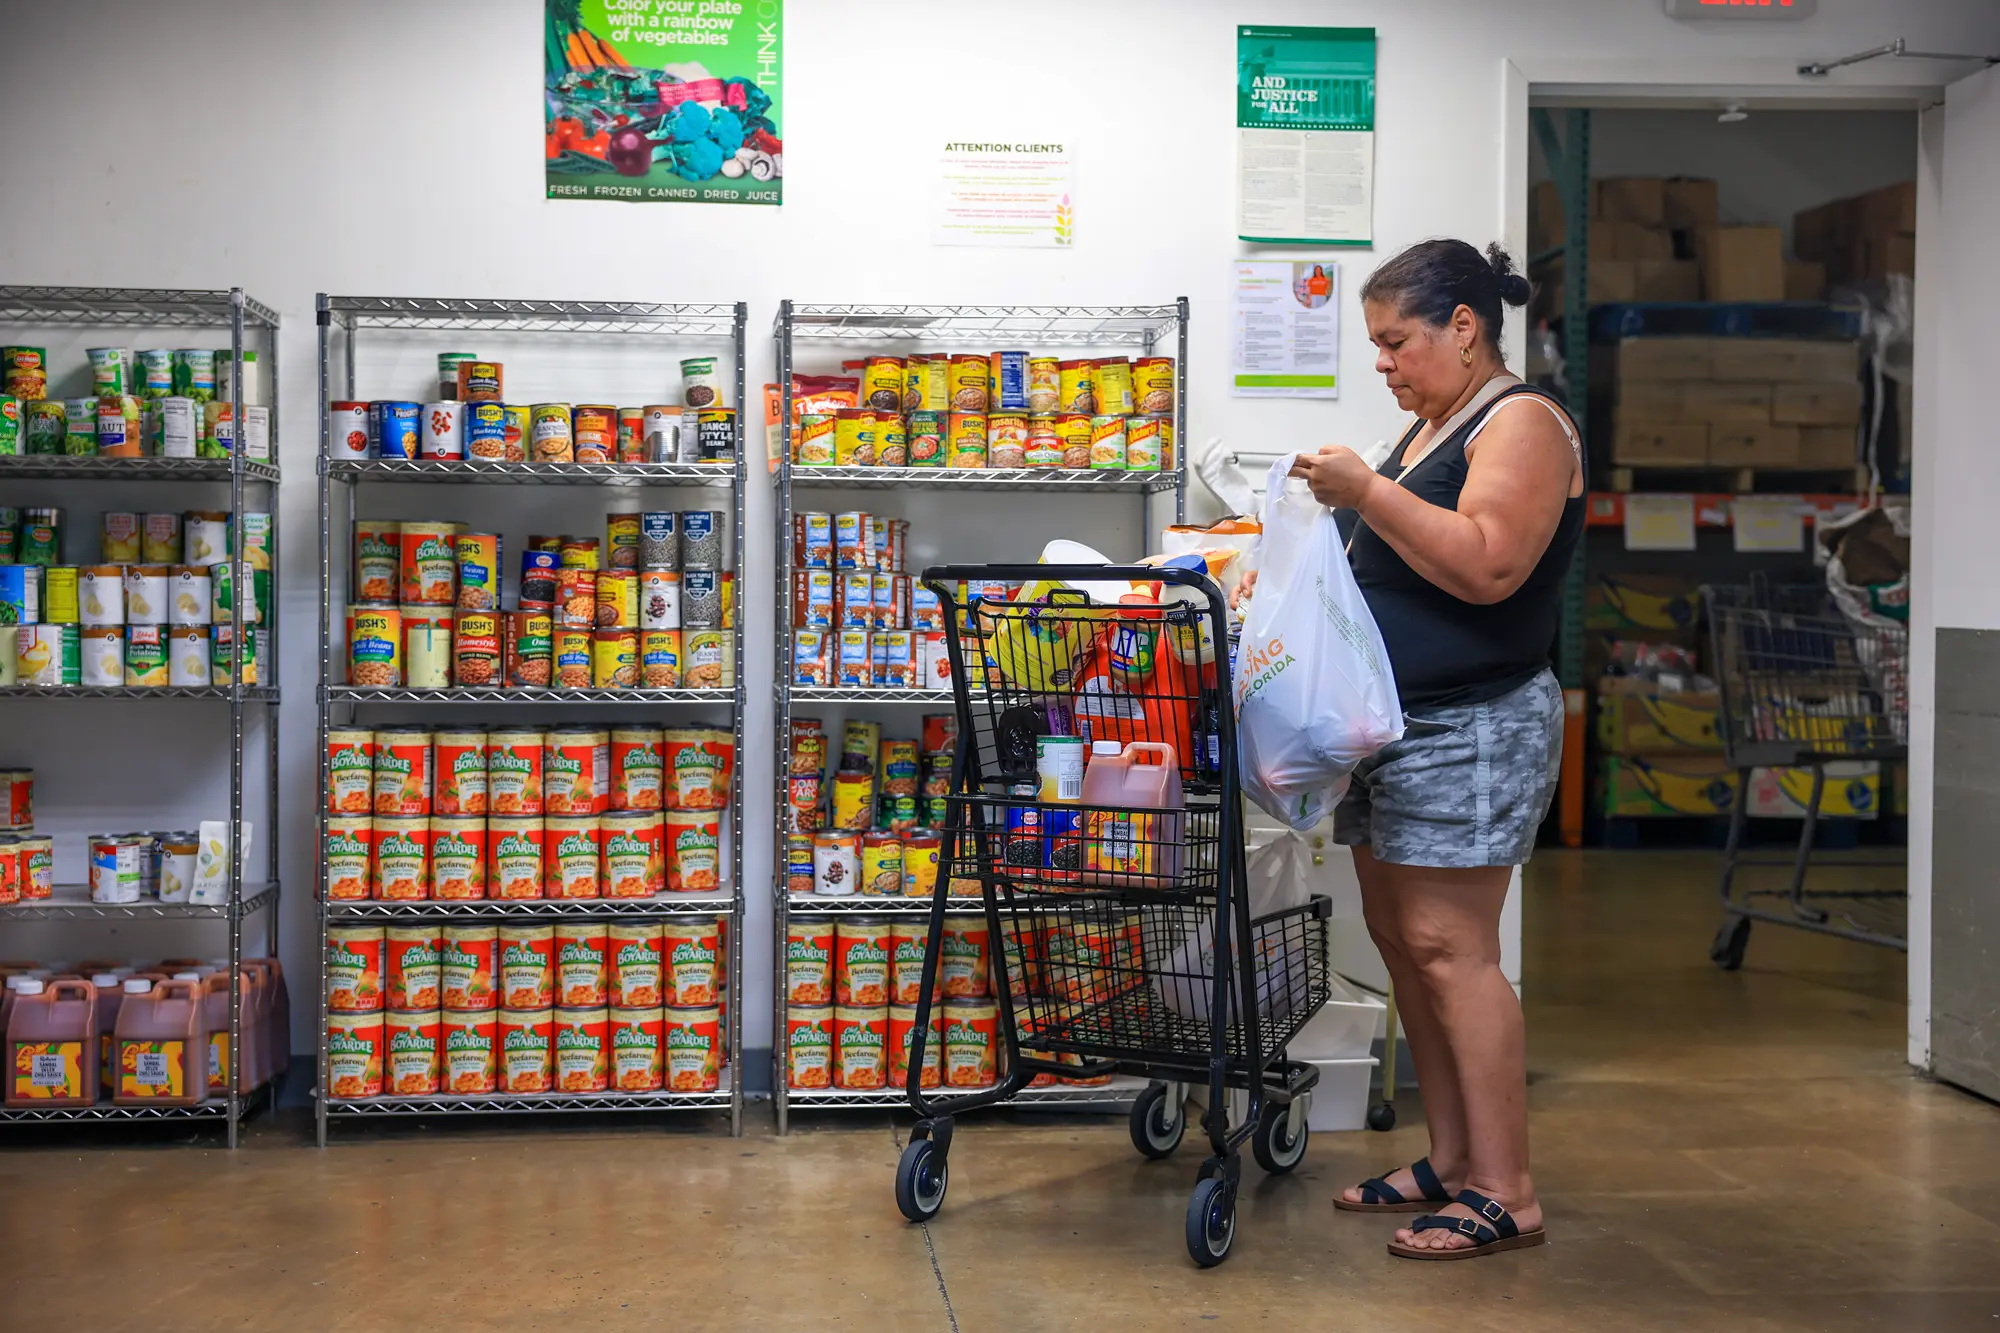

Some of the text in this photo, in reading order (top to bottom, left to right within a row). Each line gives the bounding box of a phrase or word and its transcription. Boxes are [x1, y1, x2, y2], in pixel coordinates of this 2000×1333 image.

[604, 0, 651, 11] Color
[656, 0, 695, 17] your
[699, 0, 742, 19] plate
[608, 13, 733, 30] with a rainbow
[611, 28, 729, 46] of vegetables
[757, 22, 776, 88] THINK
[1252, 76, 1286, 88] AND
[1251, 89, 1318, 102] JUSTICE
[1269, 102, 1298, 114] ALL
[945, 143, 1063, 153] ATTENTION CLIENTS
[550, 185, 778, 200] FRESH FROZEN CANNED DRIED JUICE
[701, 423, 730, 431] RANCH
[991, 418, 1024, 429] Rosarita
[700, 432, 733, 441] STYLE
[356, 619, 386, 629] BUSH'S
[462, 621, 492, 631] BUSH'S
[369, 642, 392, 650] Beans
[458, 639, 496, 647] Homestyle
[648, 637, 671, 645] BUSH'S
[1245, 654, 1296, 702] FLORIDA
[792, 727, 807, 736] Van
[797, 789, 816, 798] ARC
[329, 842, 368, 854] OYARDEE
[379, 842, 424, 856] BOYARDEE
[433, 842, 478, 856] BOYARDEE
[497, 842, 540, 856] BOYARDEE
[607, 842, 650, 855] BOYARDEE
[383, 862, 419, 870] Beefaroni
[437, 862, 472, 870] Beefaroni
[502, 860, 536, 868] Beefaroni
[611, 859, 646, 867] Beefaroni
[503, 950, 548, 965] BOYARDEE
[559, 949, 603, 963] BOYARDEE
[618, 949, 661, 964] BOYARDEE
[672, 948, 715, 963] BOYARDEE
[563, 968, 598, 976] Beefaroni
[622, 969, 658, 977] Beefaroni
[677, 968, 711, 976] Beefaroni
[390, 1037, 435, 1052] BOYARDEE
[447, 1036, 491, 1050] BOYARDEE
[504, 1036, 548, 1050] BOYARDEE
[557, 1035, 600, 1049] BOYARDEE
[614, 1034, 658, 1048] BOYARDEE
[840, 1032, 883, 1045] BOYARDEE
[395, 1057, 430, 1065] Beefaroni
[508, 1055, 543, 1063] Beefaroni
[844, 1051, 878, 1059] Beefaroni
